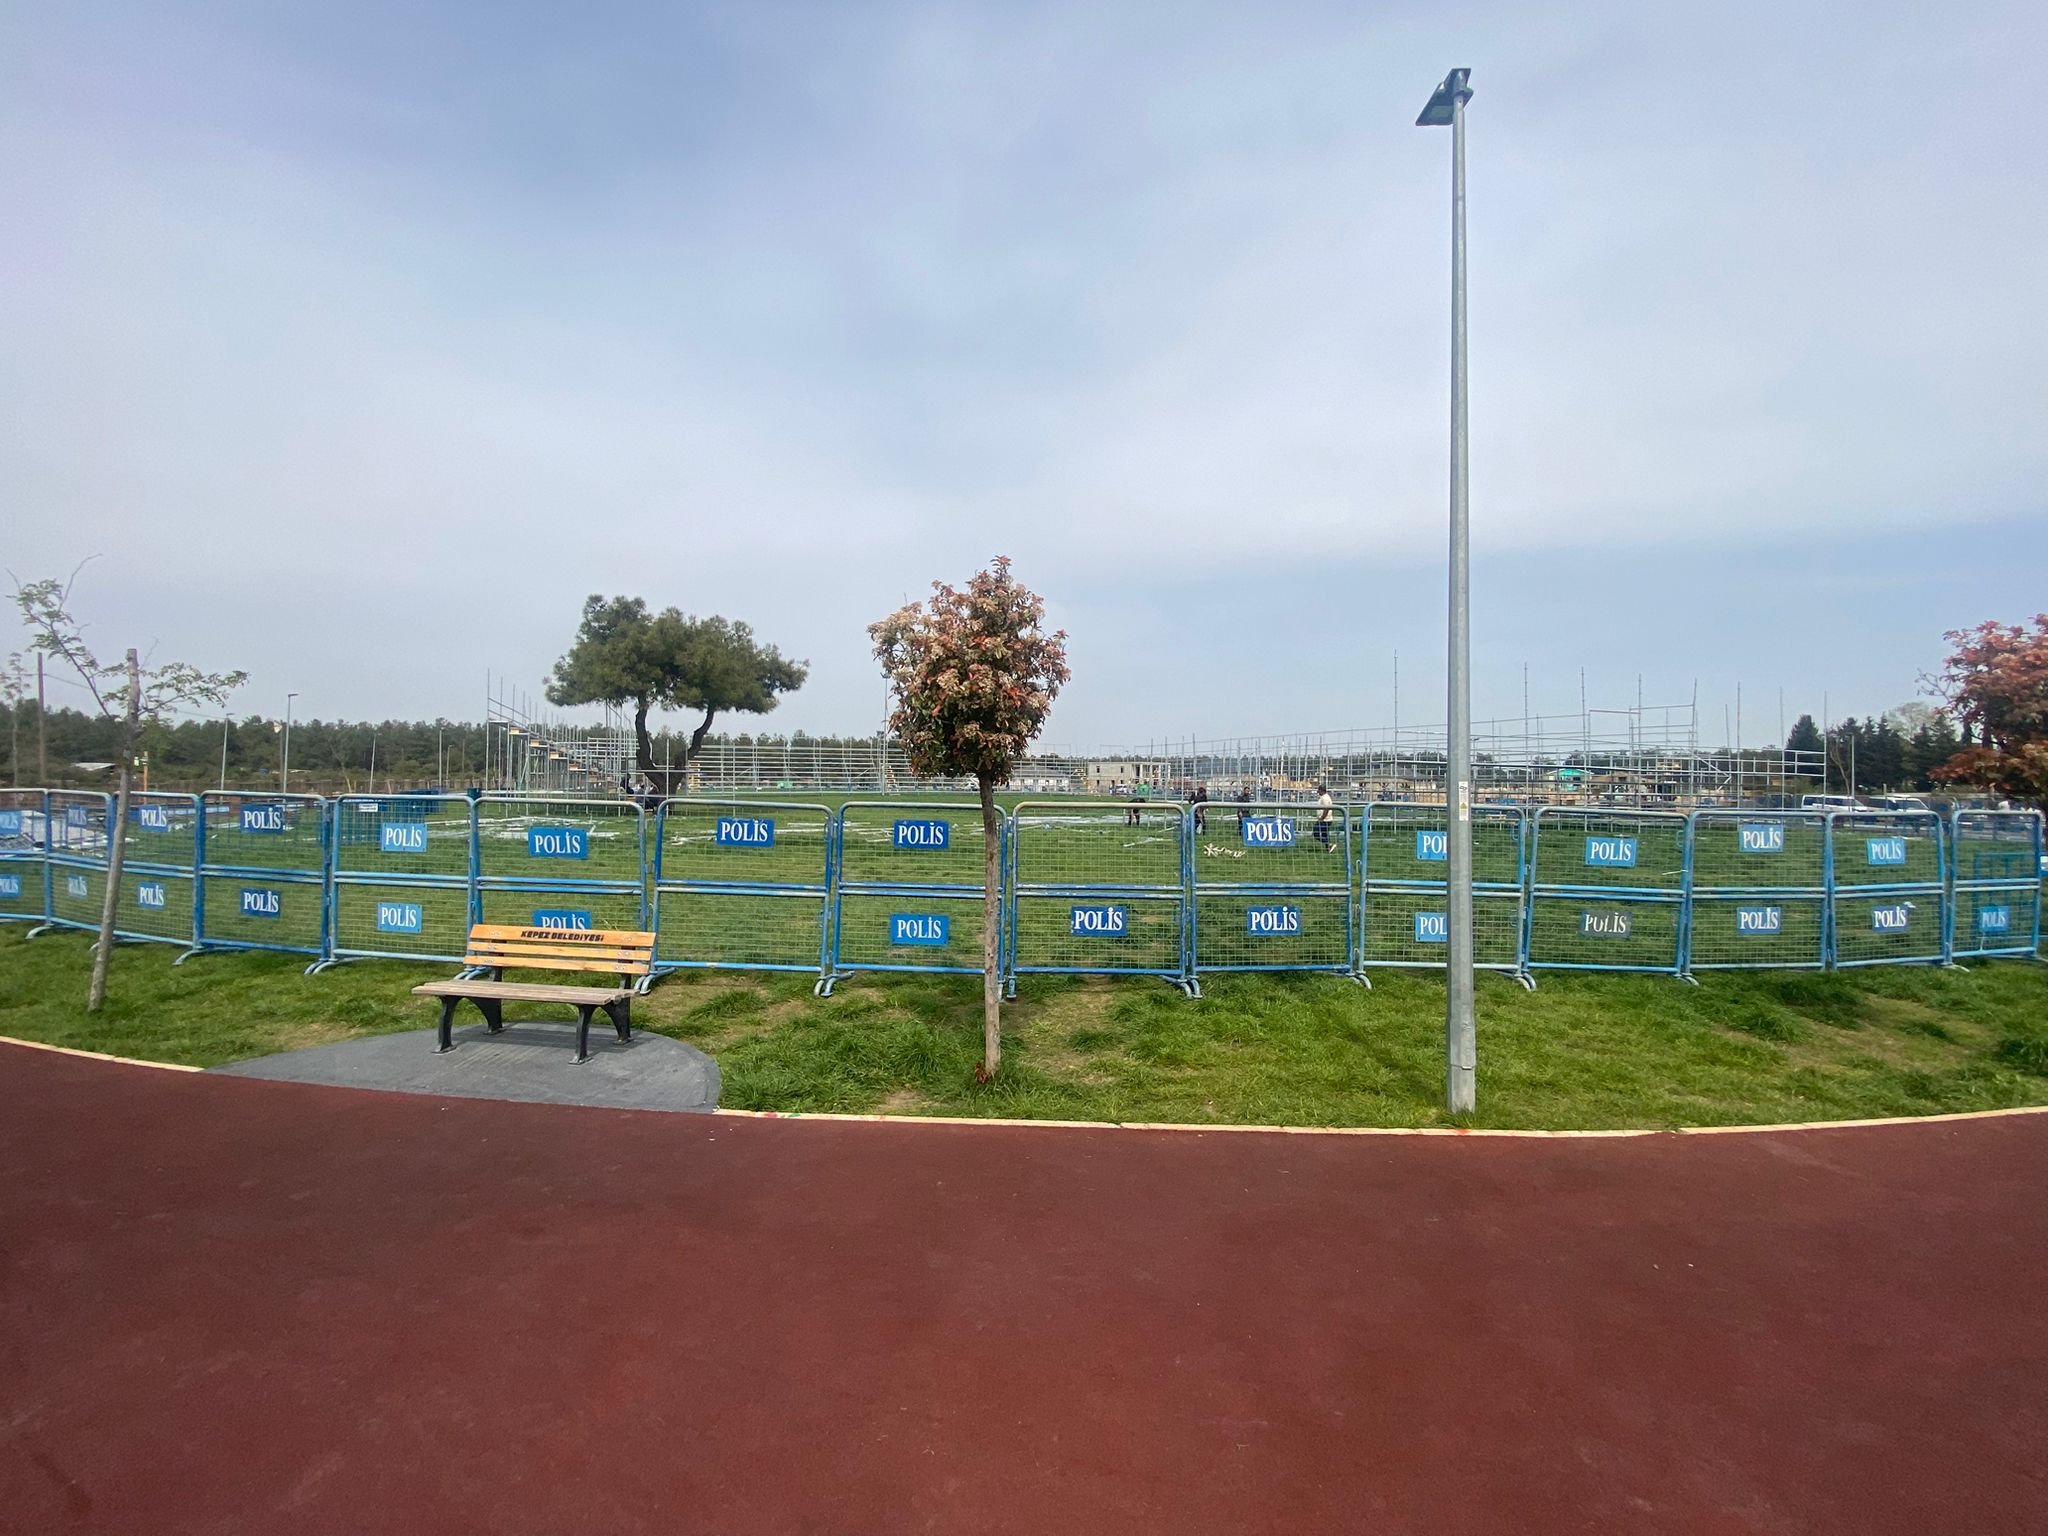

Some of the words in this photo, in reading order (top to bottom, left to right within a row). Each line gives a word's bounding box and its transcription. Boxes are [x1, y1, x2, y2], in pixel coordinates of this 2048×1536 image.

[142, 806, 168, 827] POLİS
[243, 807, 281, 829] POLİS
[385, 826, 422, 848] POLİS
[721, 820, 768, 842] POLİS
[898, 822, 944, 845] POLİS
[1246, 819, 1292, 842] POLİS
[1743, 827, 1781, 849] POLİS
[534, 831, 581, 854] POLİS
[1590, 839, 1632, 861] POLİS
[1871, 839, 1902, 860] POLİS
[139, 885, 164, 906] POLİS
[243, 891, 279, 913] POLİS
[381, 905, 417, 928] POLİS
[1074, 906, 1123, 931] POLİS
[1250, 906, 1298, 931] POLİS
[1584, 912, 1627, 933] POLİS
[1739, 907, 1779, 930] POLİS
[1873, 906, 1907, 928] POLİS
[520, 931, 551, 939] KEPEZ
[897, 917, 941, 939] POLİS
